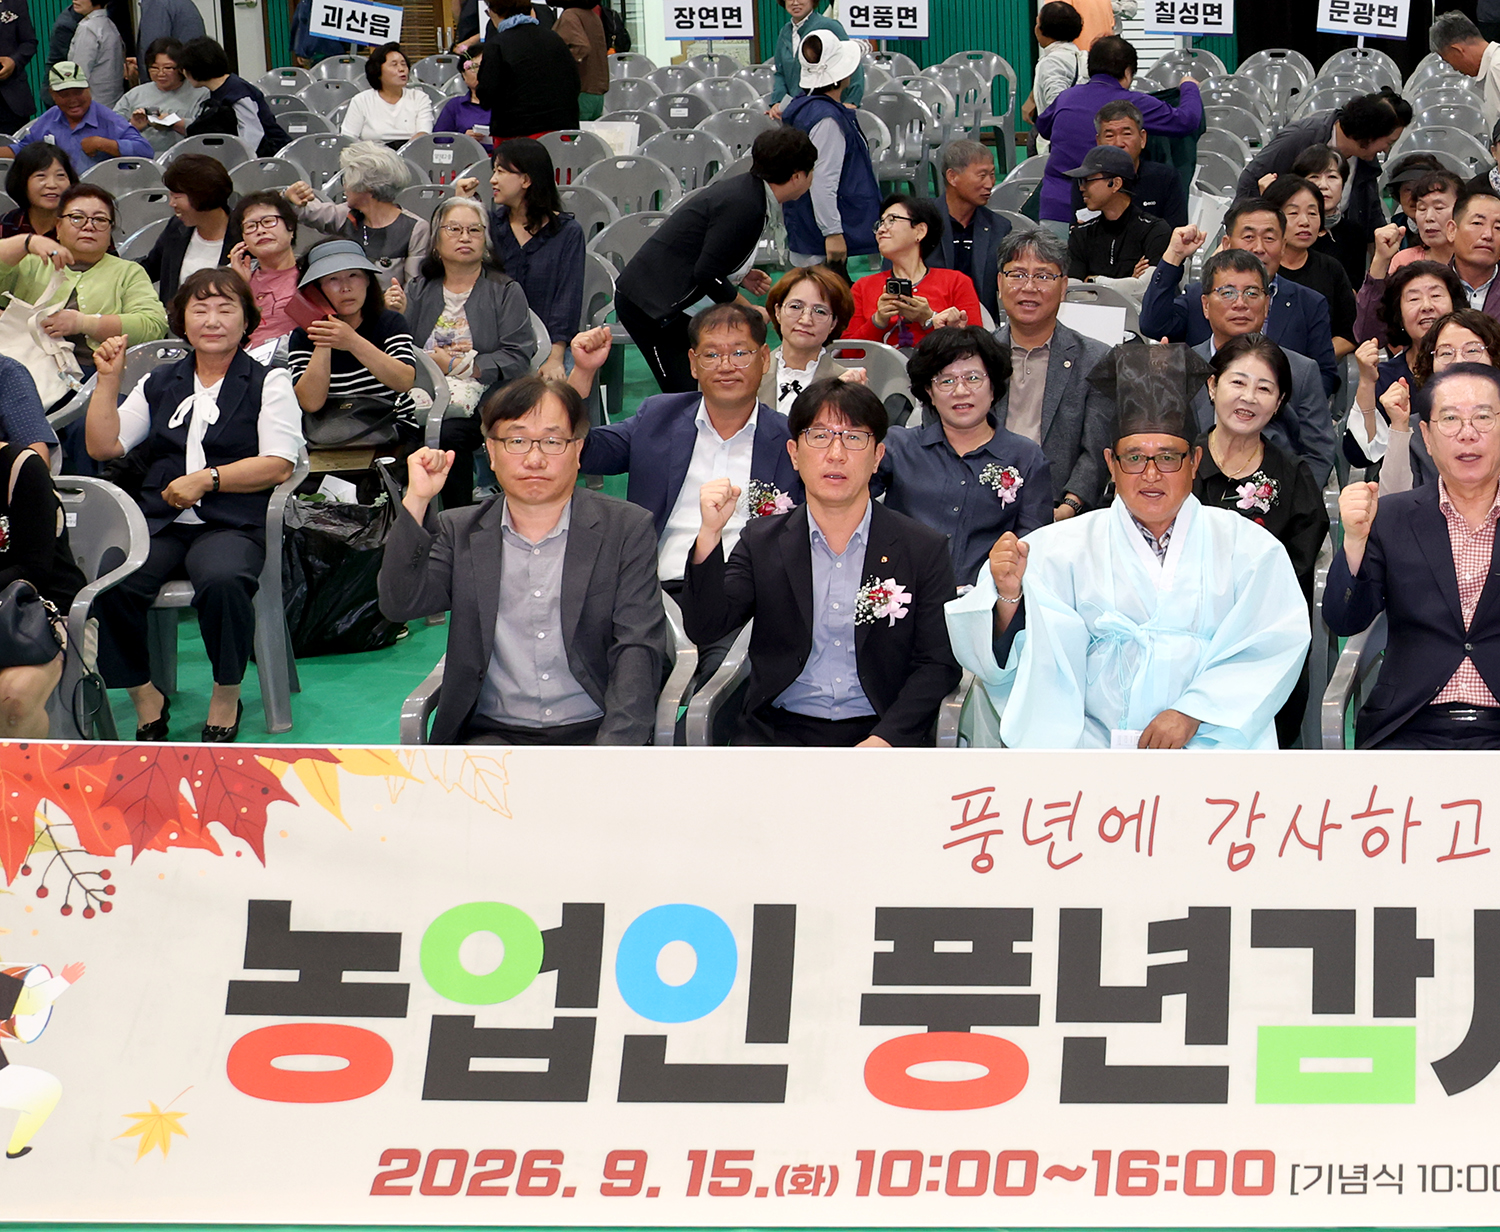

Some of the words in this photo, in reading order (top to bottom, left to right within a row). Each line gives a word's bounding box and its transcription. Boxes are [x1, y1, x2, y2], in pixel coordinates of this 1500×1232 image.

[321, 5, 391, 38] 괴산읍
[674, 6, 743, 29] 장연면
[849, 5, 918, 29] 연풍면
[1155, 0, 1223, 26] 칠성면
[1329, 0, 1398, 28] 문광면
[943, 786, 1161, 874] 풍년에
[225, 899, 797, 1104] 농업인
[369, 1148, 577, 1198] 2026.
[600, 1150, 660, 1198] 9.
[686, 1150, 840, 1198] 15.(화)
[856, 1150, 1275, 1197] 10:00~16:00
[1290, 1164, 1404, 1196] [기념식
